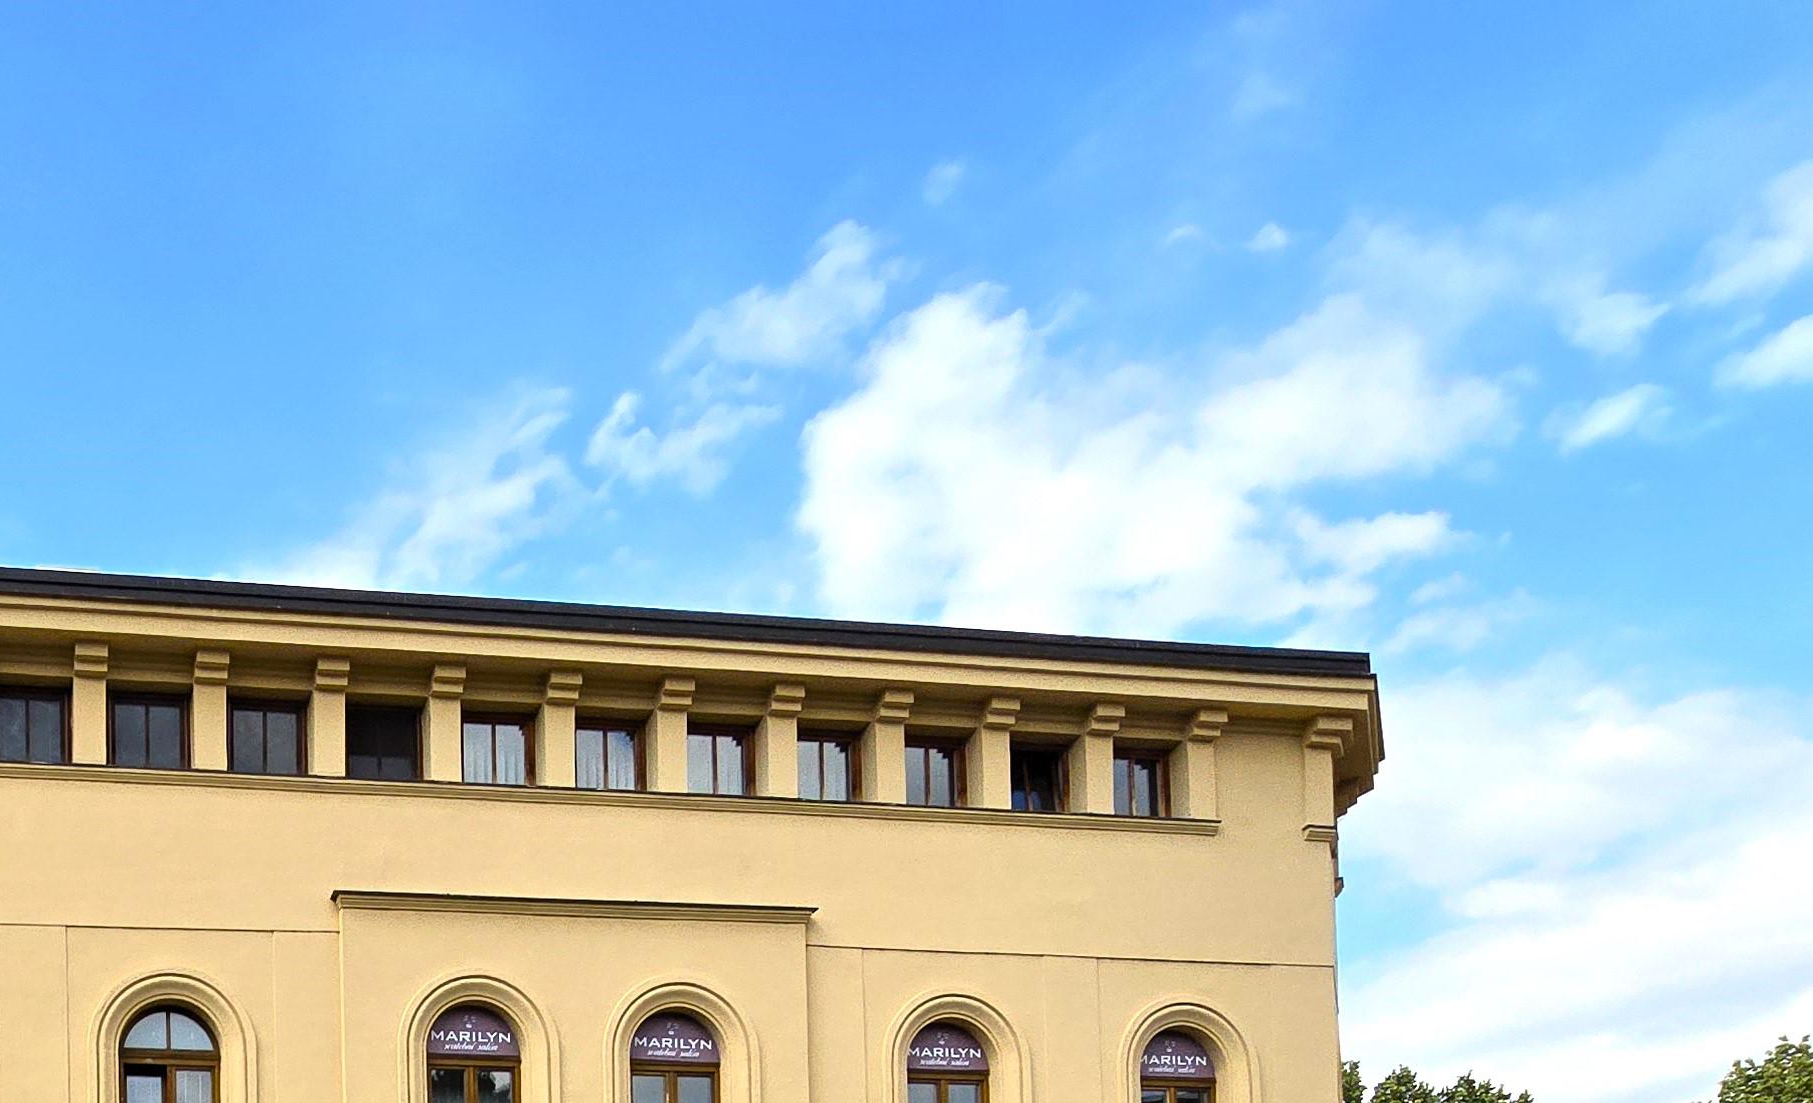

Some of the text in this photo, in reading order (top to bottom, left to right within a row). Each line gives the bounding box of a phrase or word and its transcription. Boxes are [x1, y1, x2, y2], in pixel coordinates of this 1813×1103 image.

[431, 1030, 511, 1043] MARILYN
[634, 1036, 712, 1050] MARILYN
[907, 1047, 982, 1058] MARILYN
